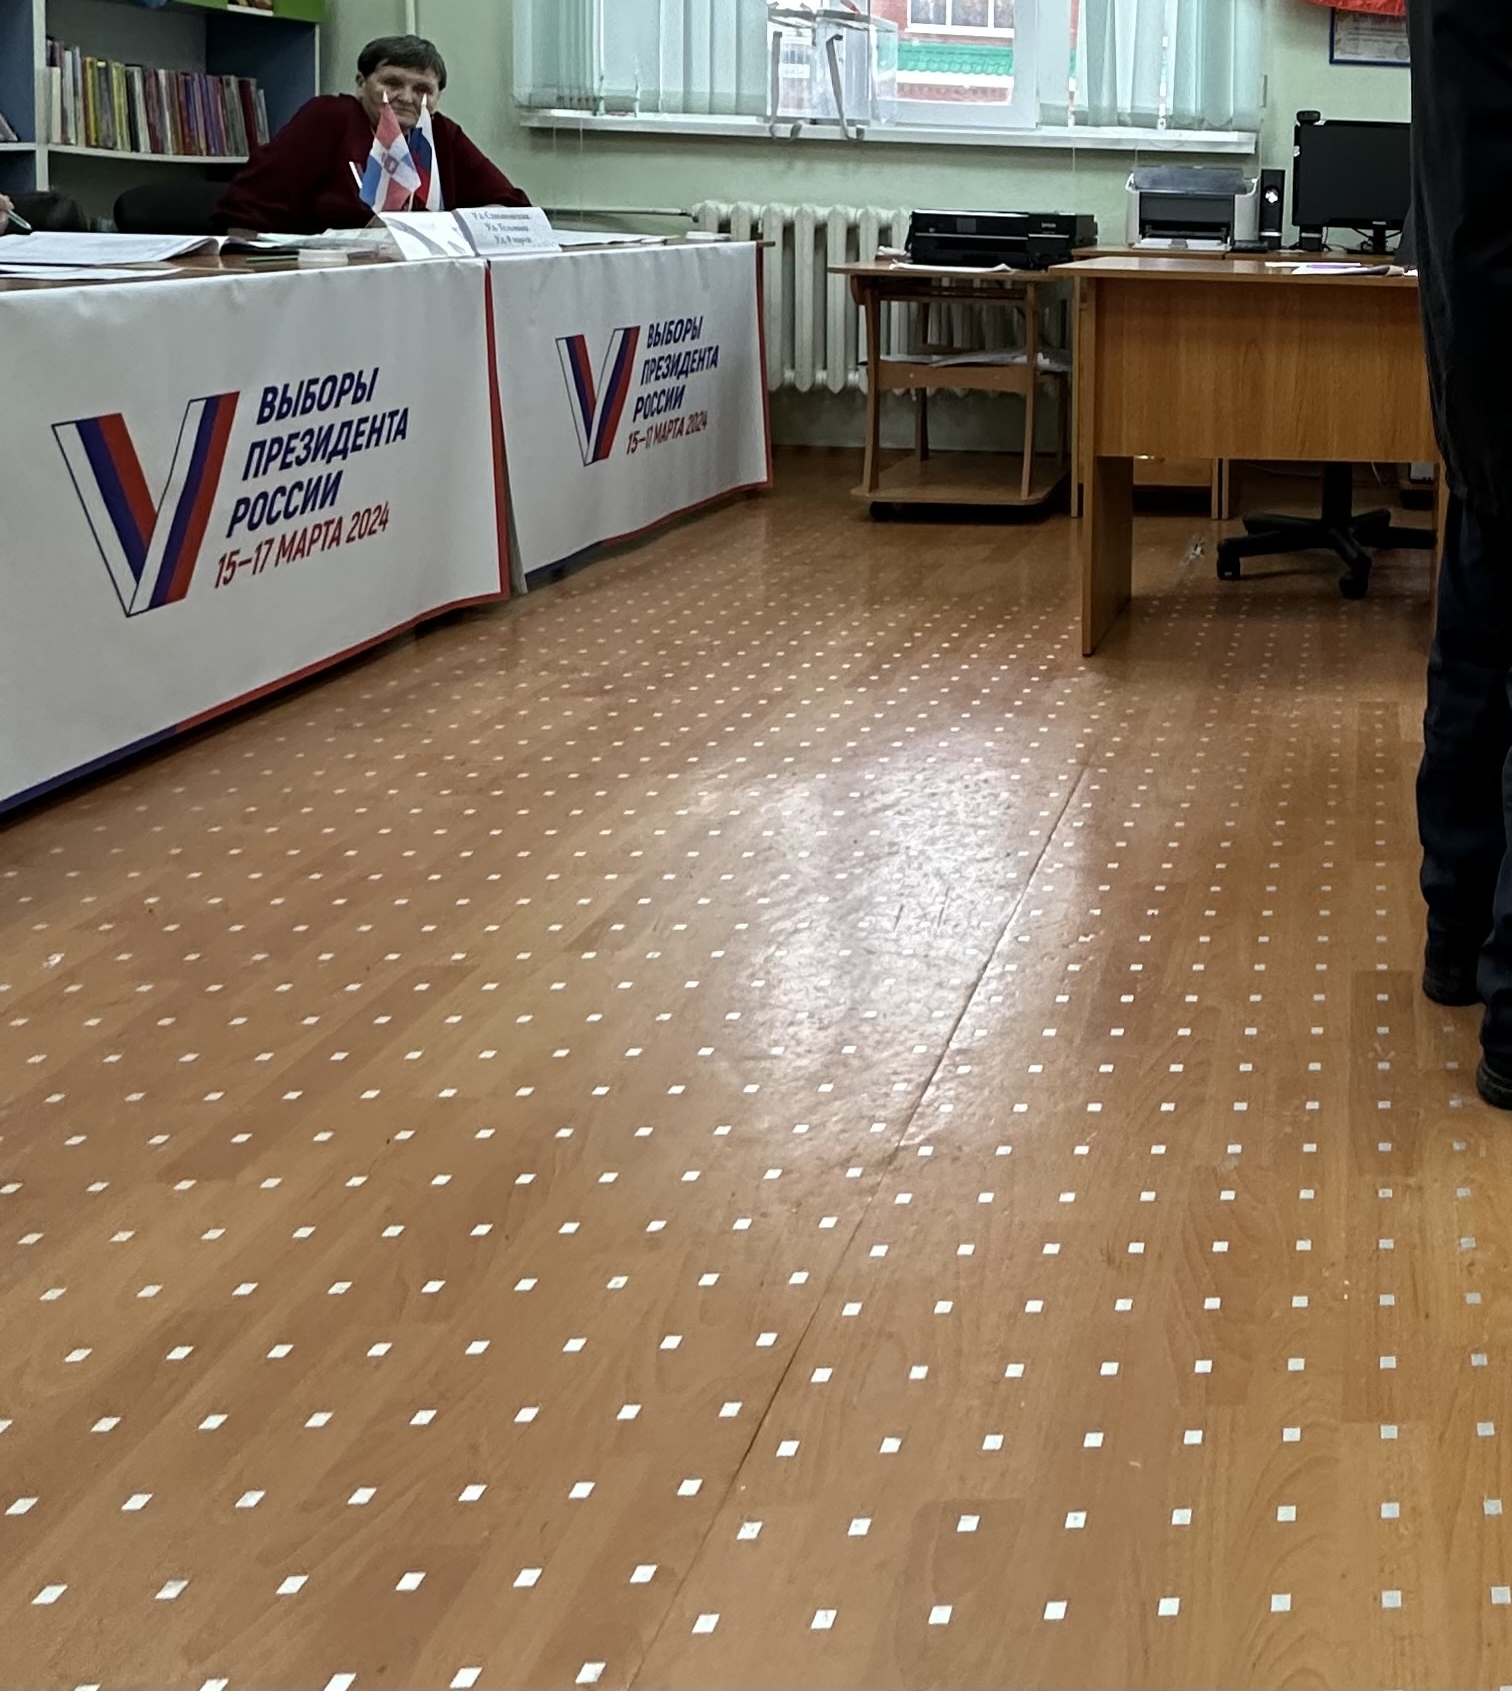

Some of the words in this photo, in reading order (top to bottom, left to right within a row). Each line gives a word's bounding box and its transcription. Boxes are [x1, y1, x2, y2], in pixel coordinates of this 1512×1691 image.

[646, 316, 703, 349] ВЫБОРЫ
[640, 345, 719, 386] ПРЕЗИДЕНТА
[256, 367, 379, 425] ВЫБОРЫ
[632, 384, 686, 423] РОССИИ
[242, 407, 409, 482] ПРЕЗИДЕНТА
[652, 416, 684, 446] МАРТА
[685, 410, 708, 435] 2024
[226, 469, 343, 539] РОССИИ
[275, 516, 343, 568] МАРТА
[346, 500, 389, 544] 2024
